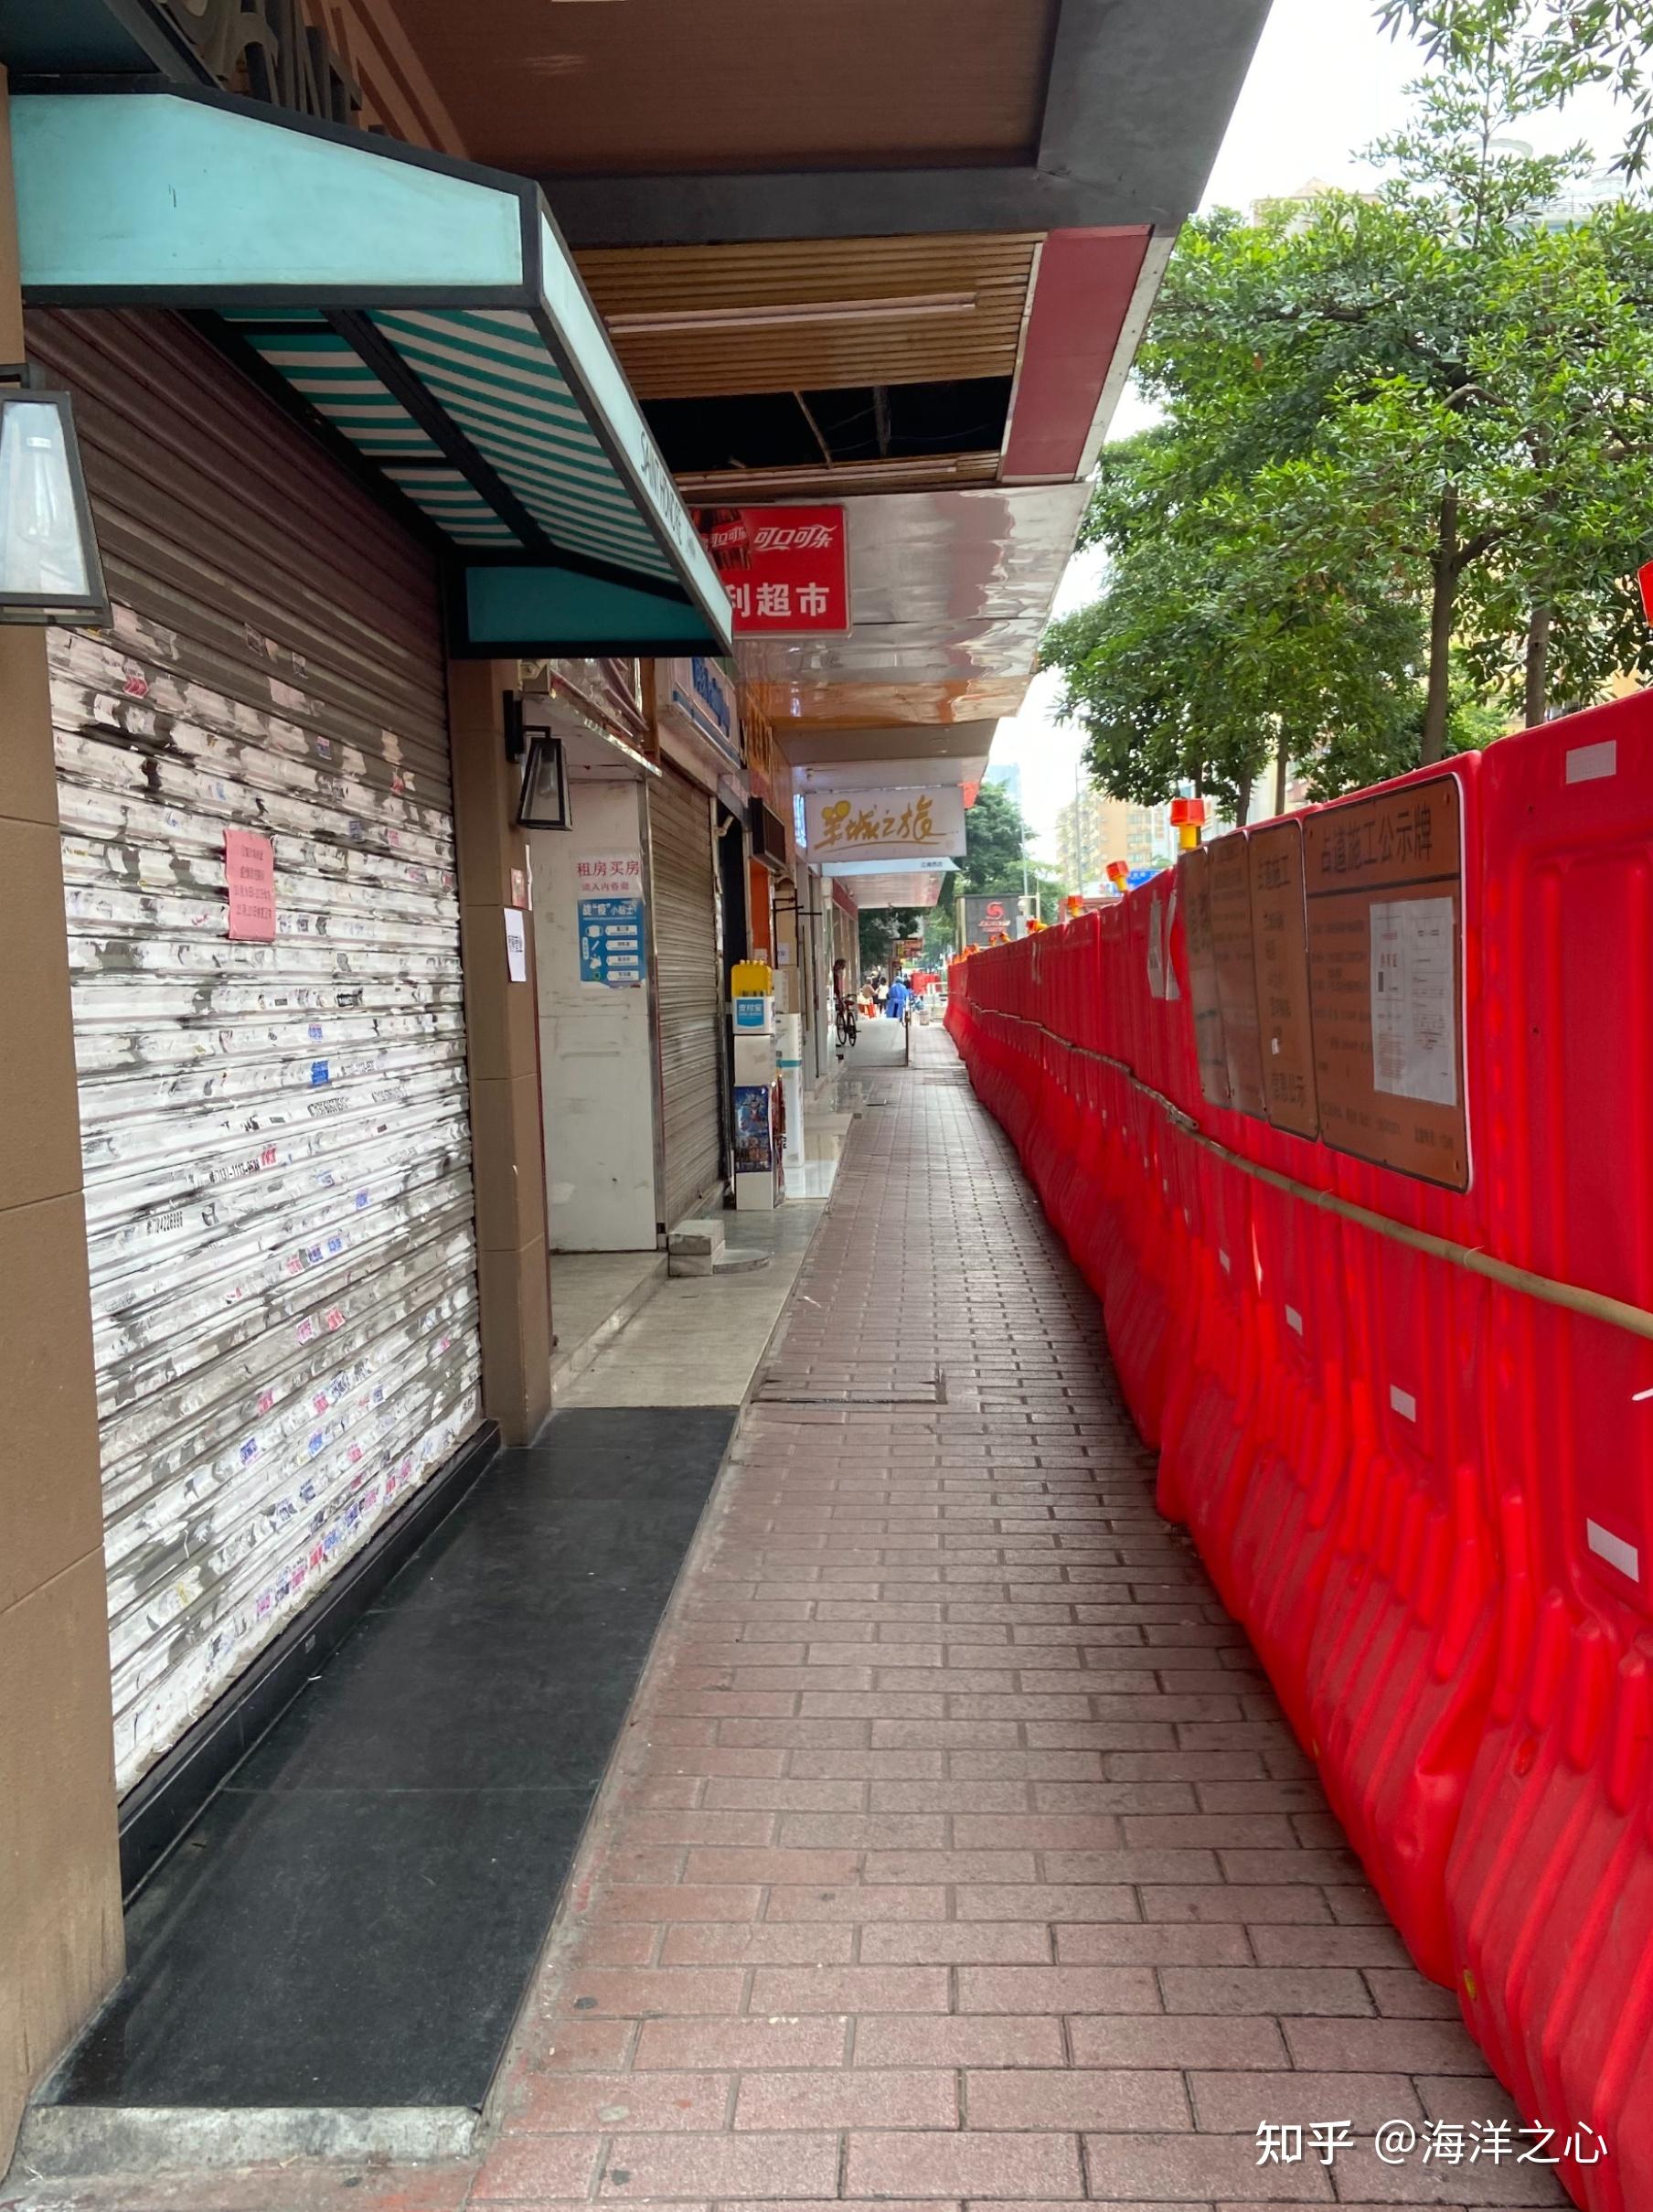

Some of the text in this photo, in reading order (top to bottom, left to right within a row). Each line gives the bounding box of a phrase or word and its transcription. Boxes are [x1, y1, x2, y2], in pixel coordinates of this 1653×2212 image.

[753, 524, 838, 552] 可口可乐
[577, 860, 640, 877] 租房买房
